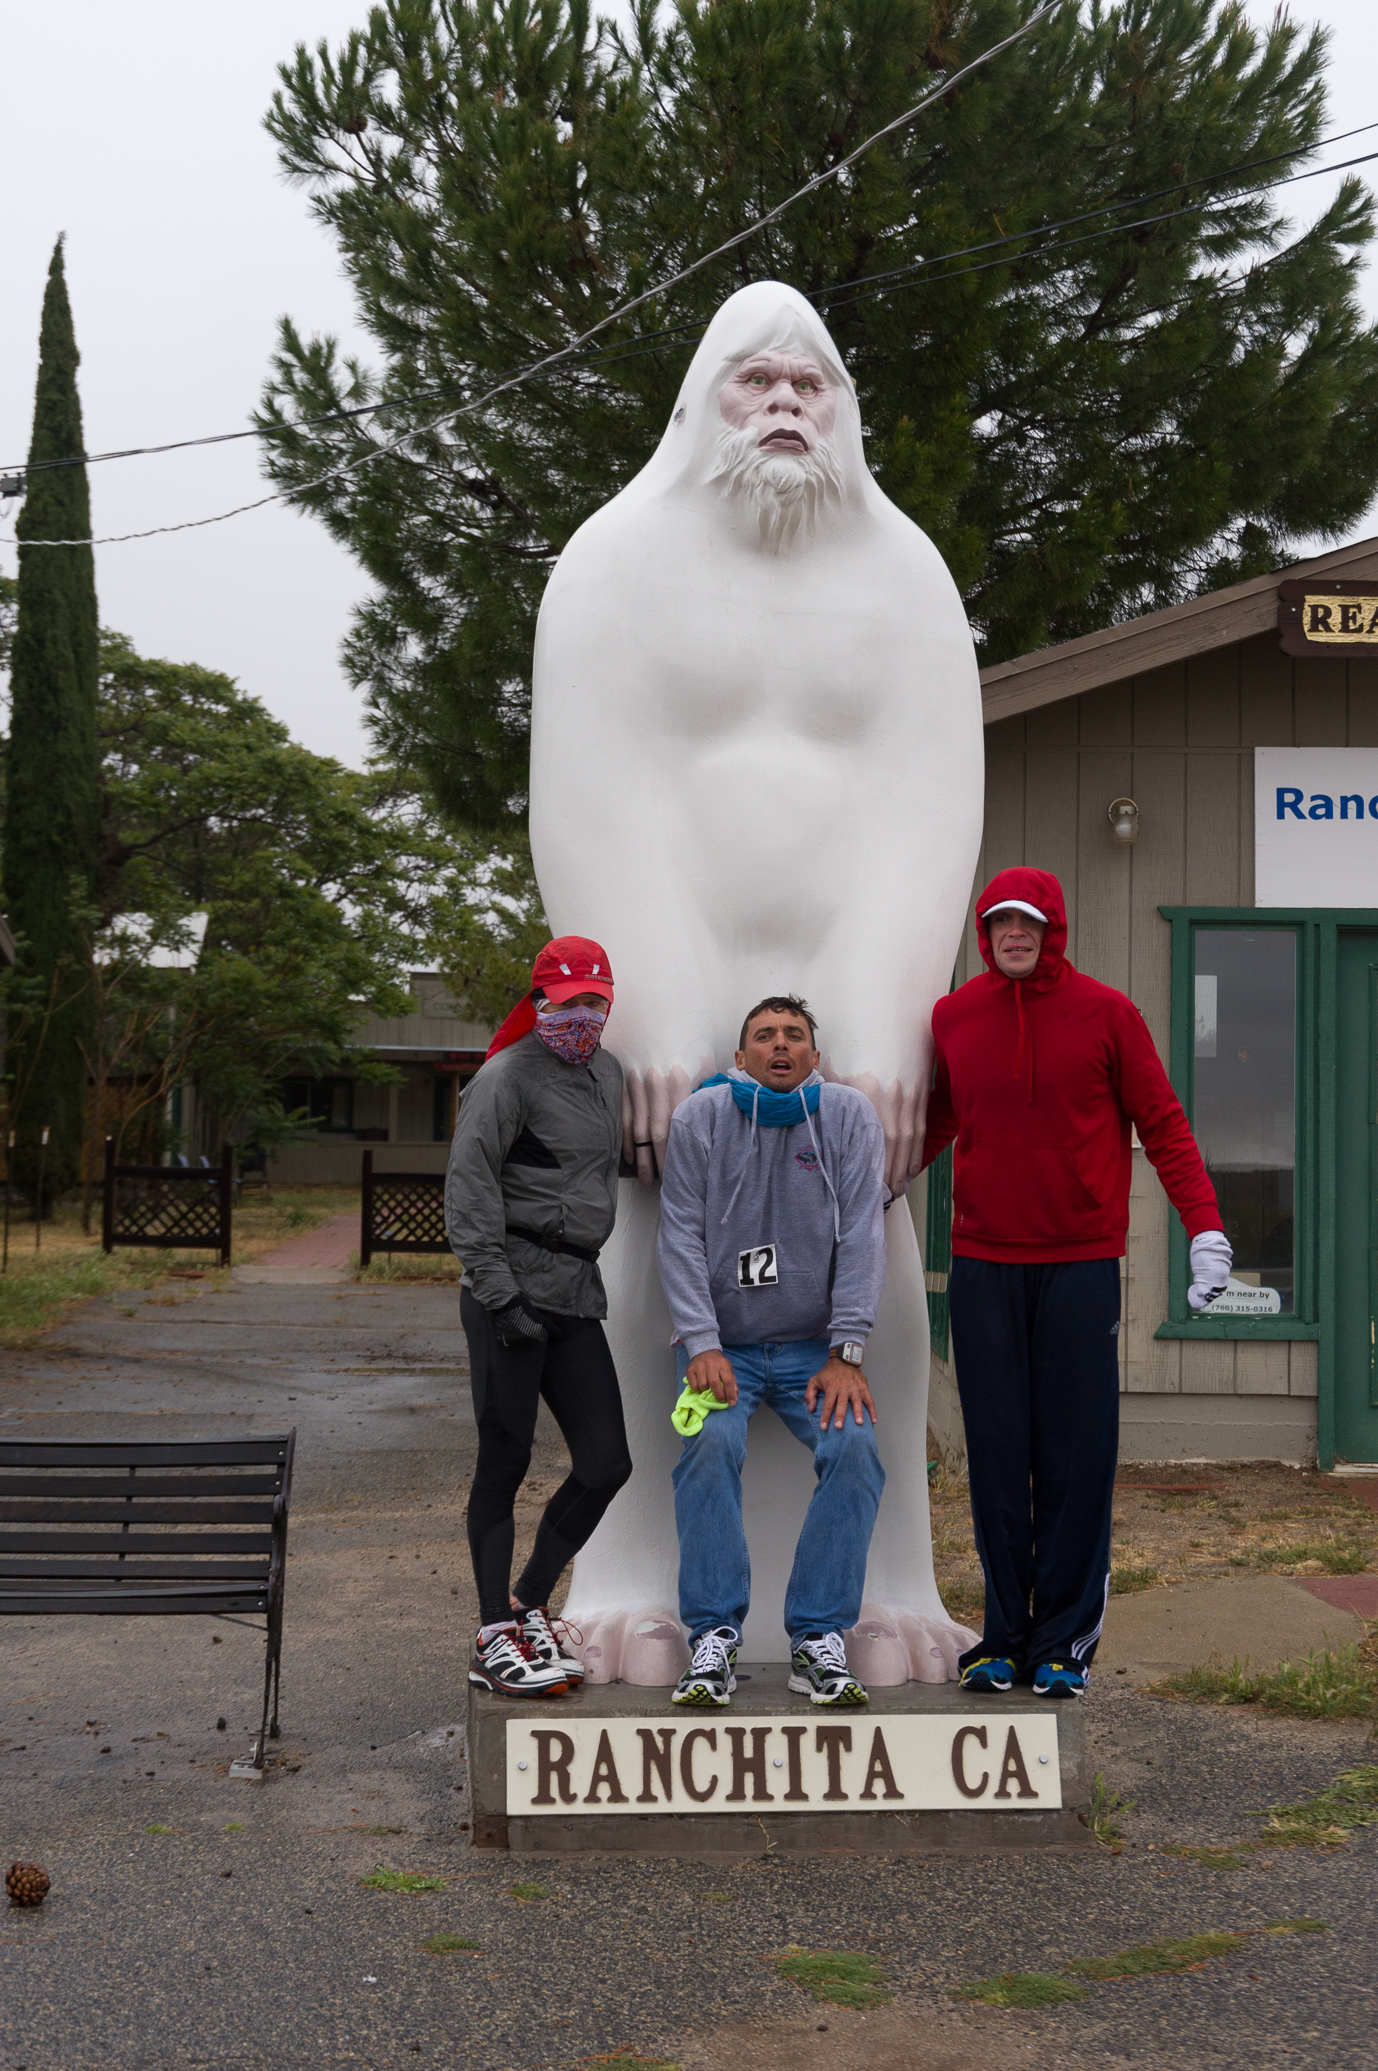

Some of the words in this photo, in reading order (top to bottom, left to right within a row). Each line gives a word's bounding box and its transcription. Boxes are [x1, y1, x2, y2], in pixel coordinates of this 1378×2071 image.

[740, 1247, 776, 1285] 12
[1260, 1291, 1270, 1299] by
[1211, 1304, 1233, 1312] (760)
[530, 1726, 905, 1805] RANCHITA
[951, 1724, 1039, 1800] CA
